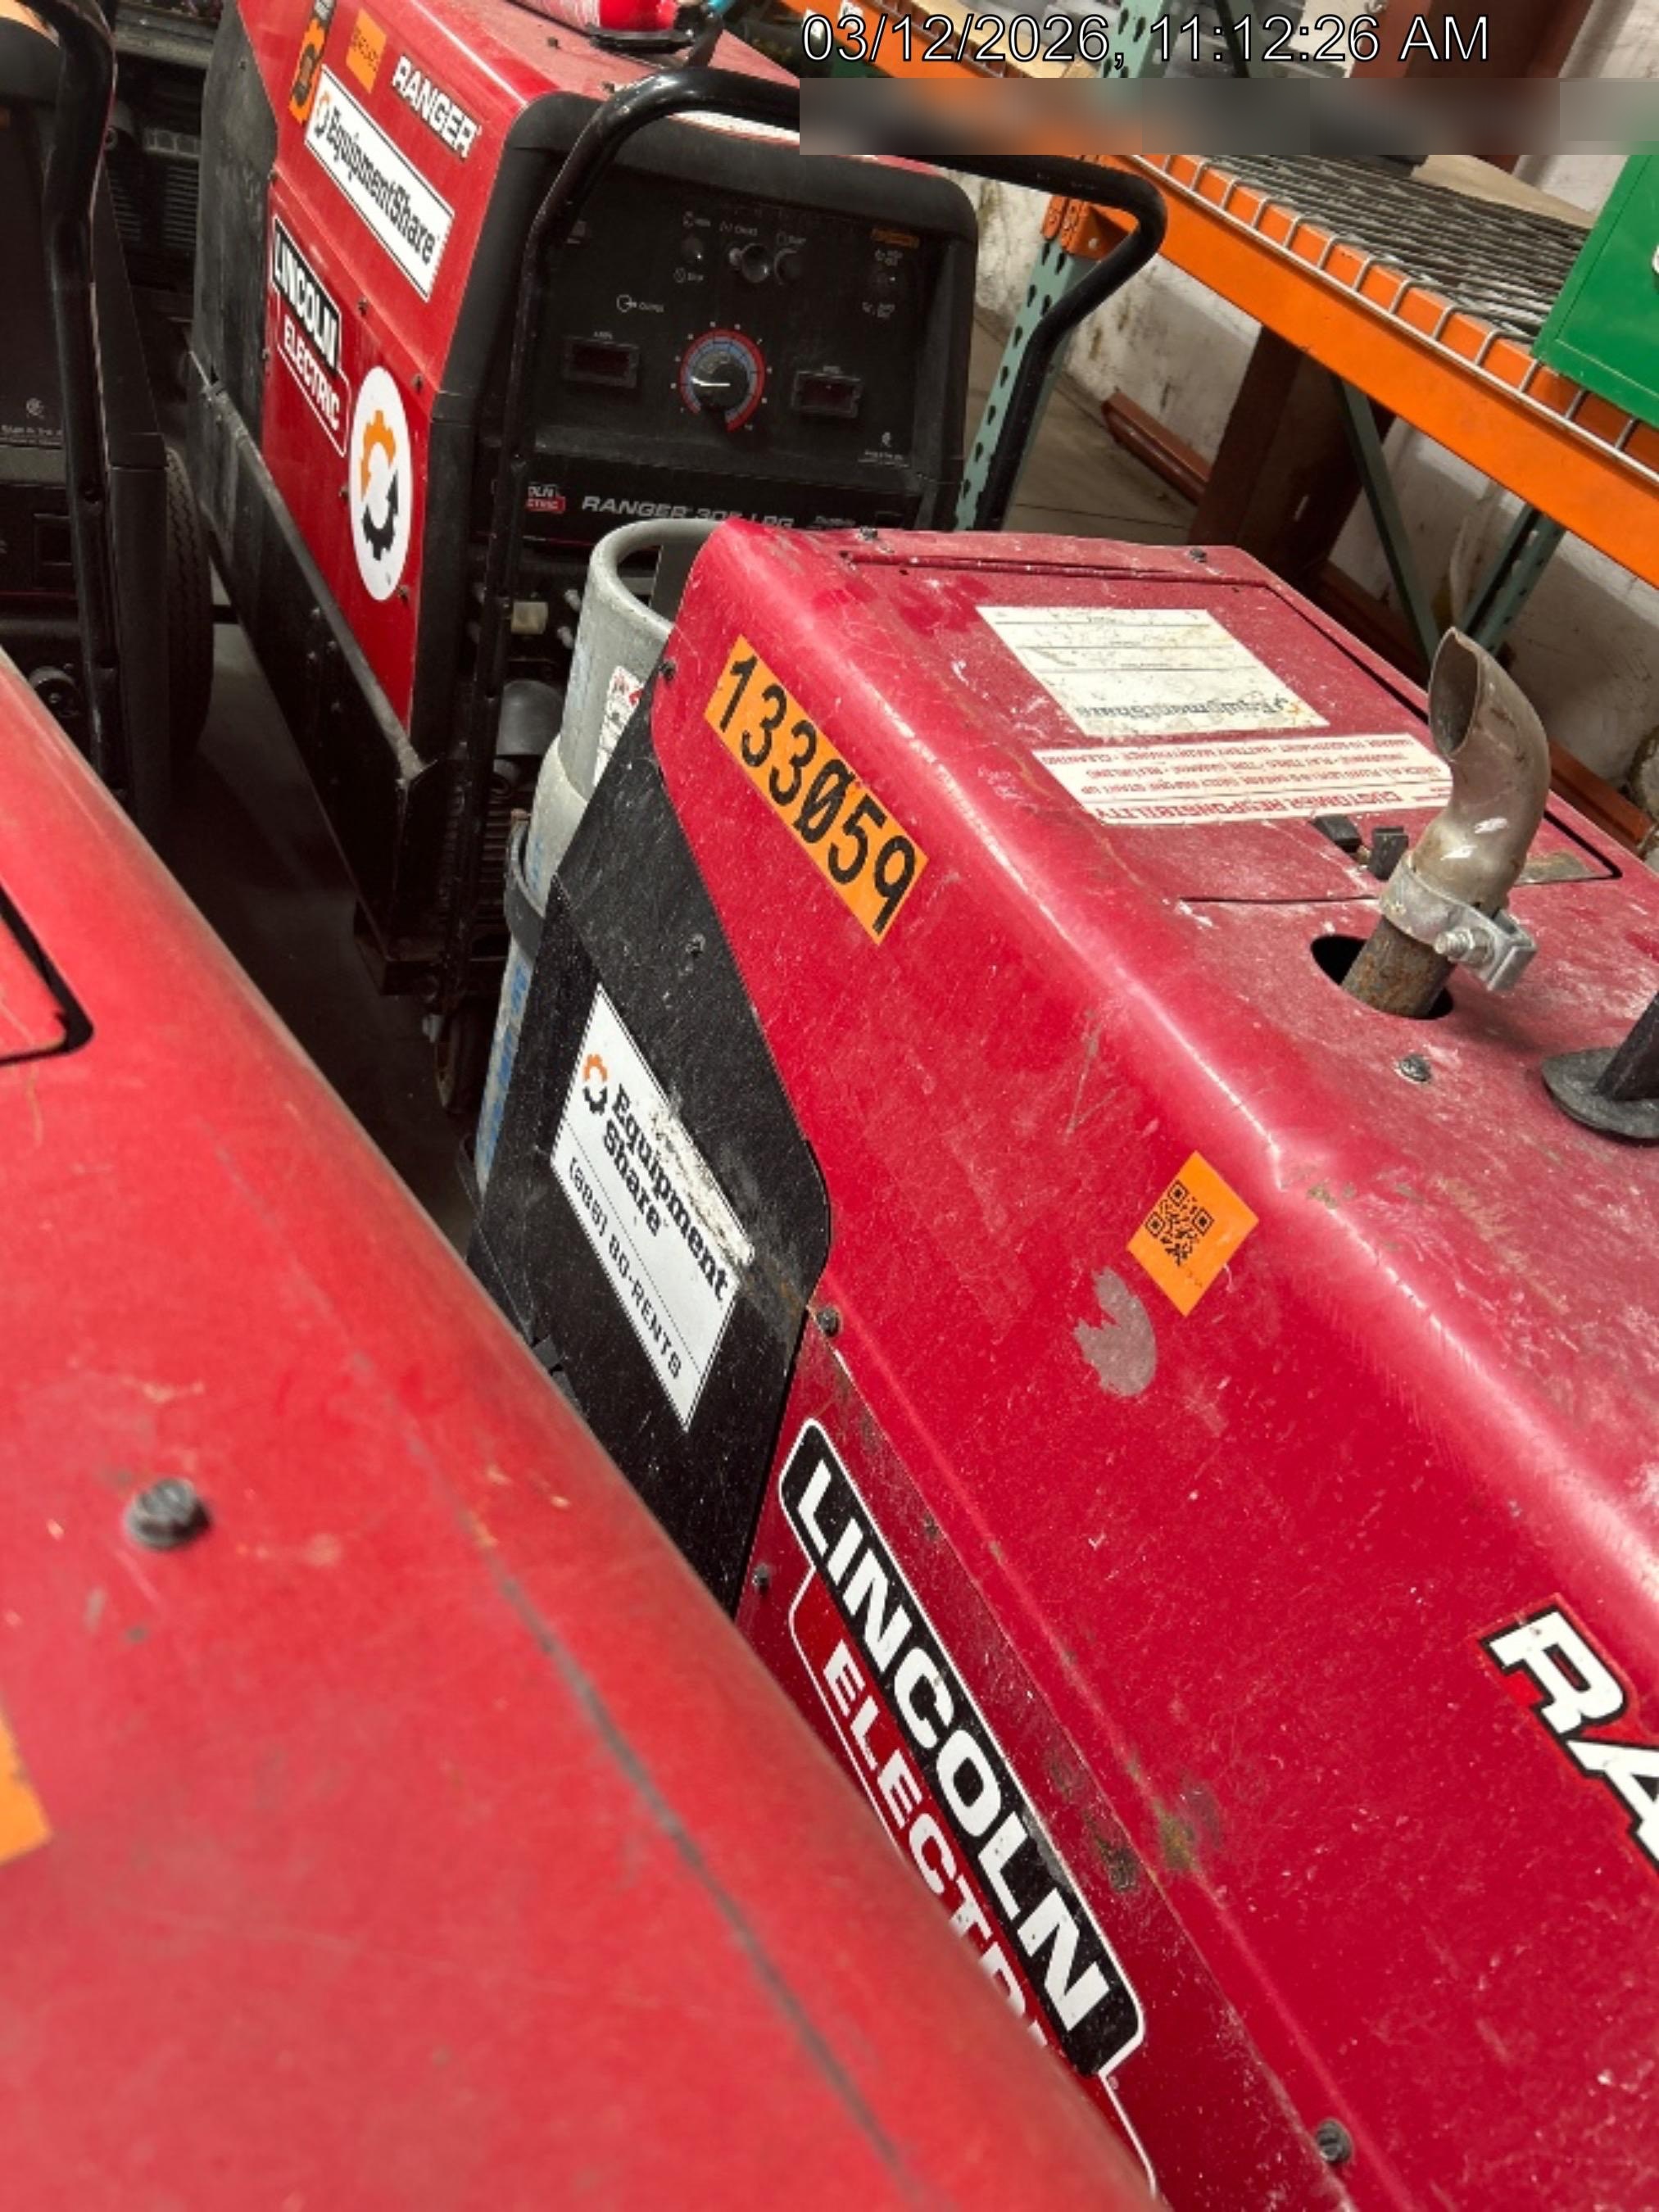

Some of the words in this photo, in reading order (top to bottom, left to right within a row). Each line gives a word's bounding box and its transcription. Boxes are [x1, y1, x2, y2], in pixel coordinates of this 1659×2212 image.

[392, 55, 477, 160] RANGER
[325, 107, 437, 265] EquipmentShare
[274, 232, 338, 370] LINCOLN
[283, 314, 340, 431] ELECTRIC
[582, 496, 687, 519] RANGER
[1095, 799, 1287, 820] RESPONSIBILITY
[1292, 791, 1403, 809] CUSTOMER
[602, 1122, 662, 1237] Share
[611, 1083, 730, 1302] Equipment
[795, 1458, 1110, 2033] LINCOLN
[821, 1640, 1048, 2047] ELECTR
